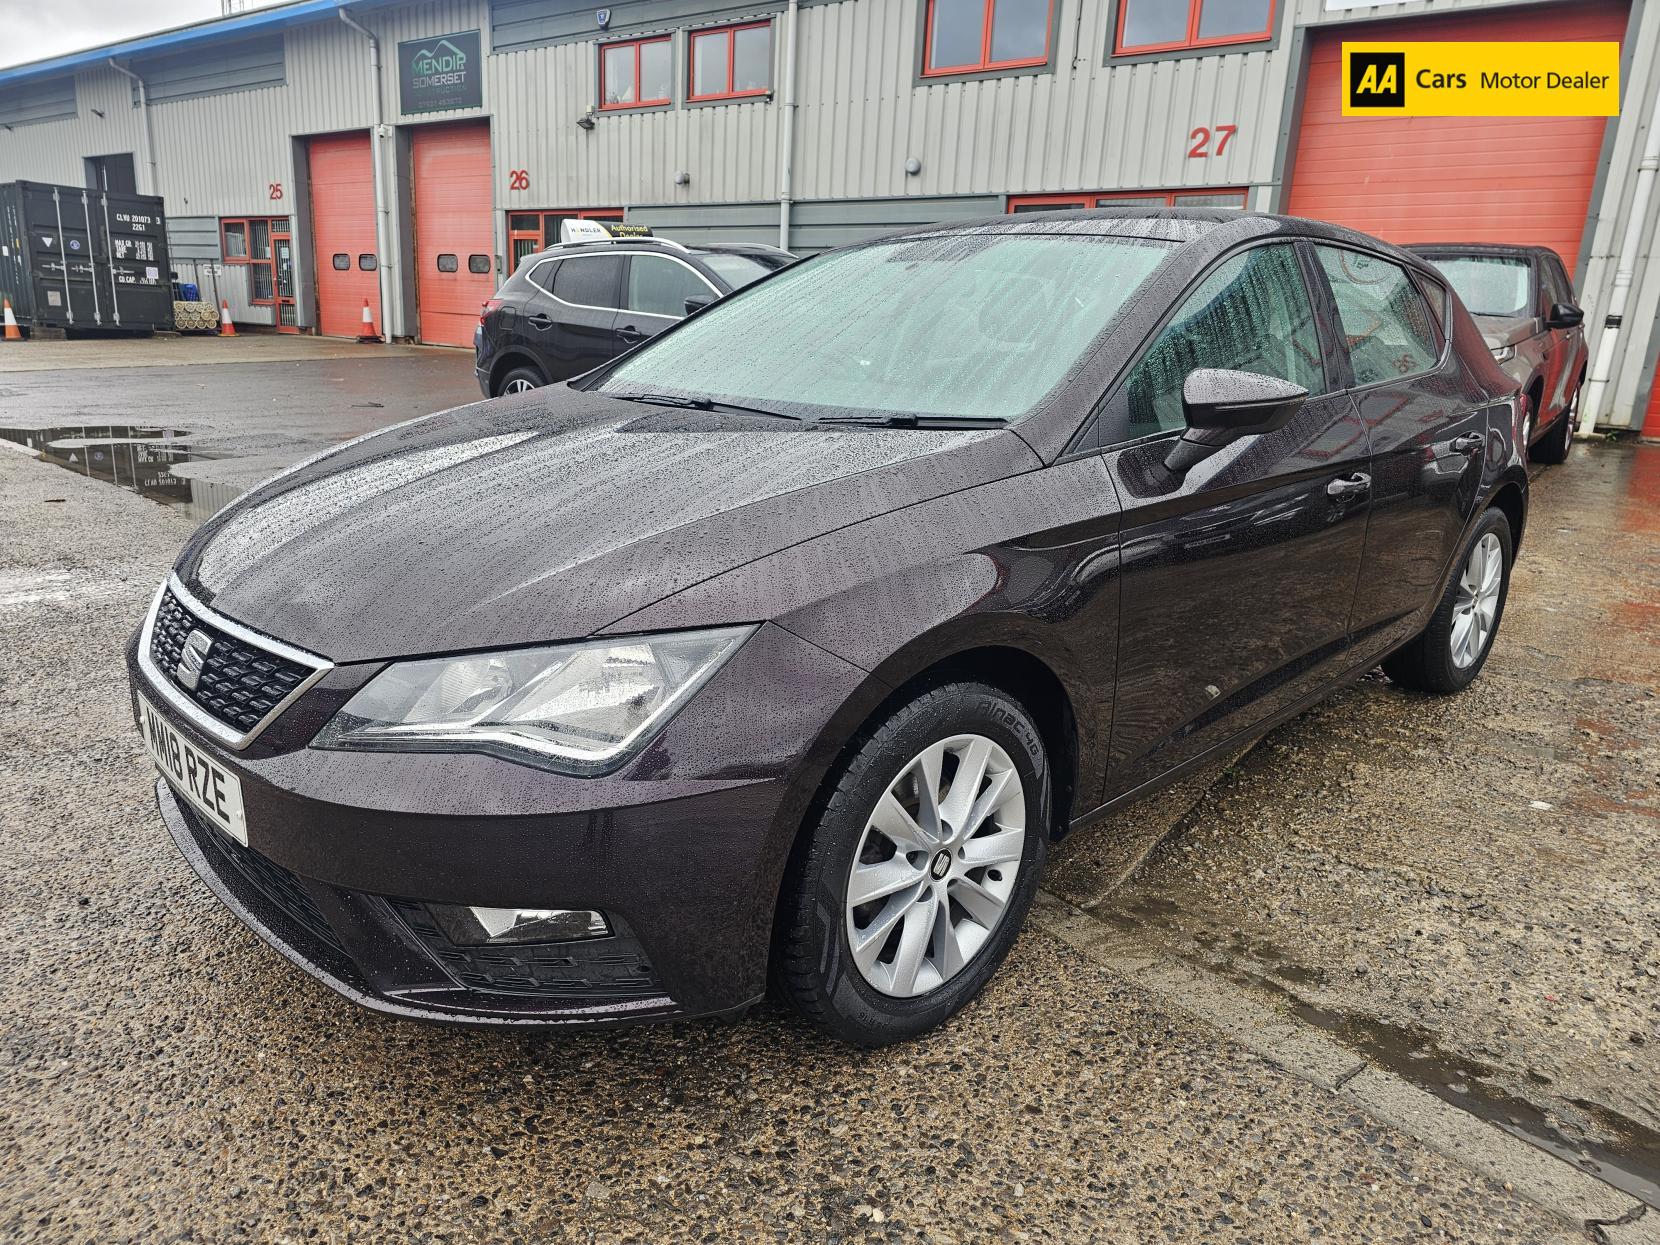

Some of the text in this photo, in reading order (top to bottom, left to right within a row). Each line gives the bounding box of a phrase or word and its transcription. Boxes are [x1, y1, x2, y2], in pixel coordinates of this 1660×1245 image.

[411, 54, 467, 74] MENDIP
[413, 72, 467, 89] SOMERSET
[1188, 125, 1238, 158] 27
[510, 170, 529, 190] 26
[269, 184, 283, 200] 25
[132, 215, 151, 223] 201073
[611, 224, 648, 232] Authorised
[184, 743, 231, 824] RZE
